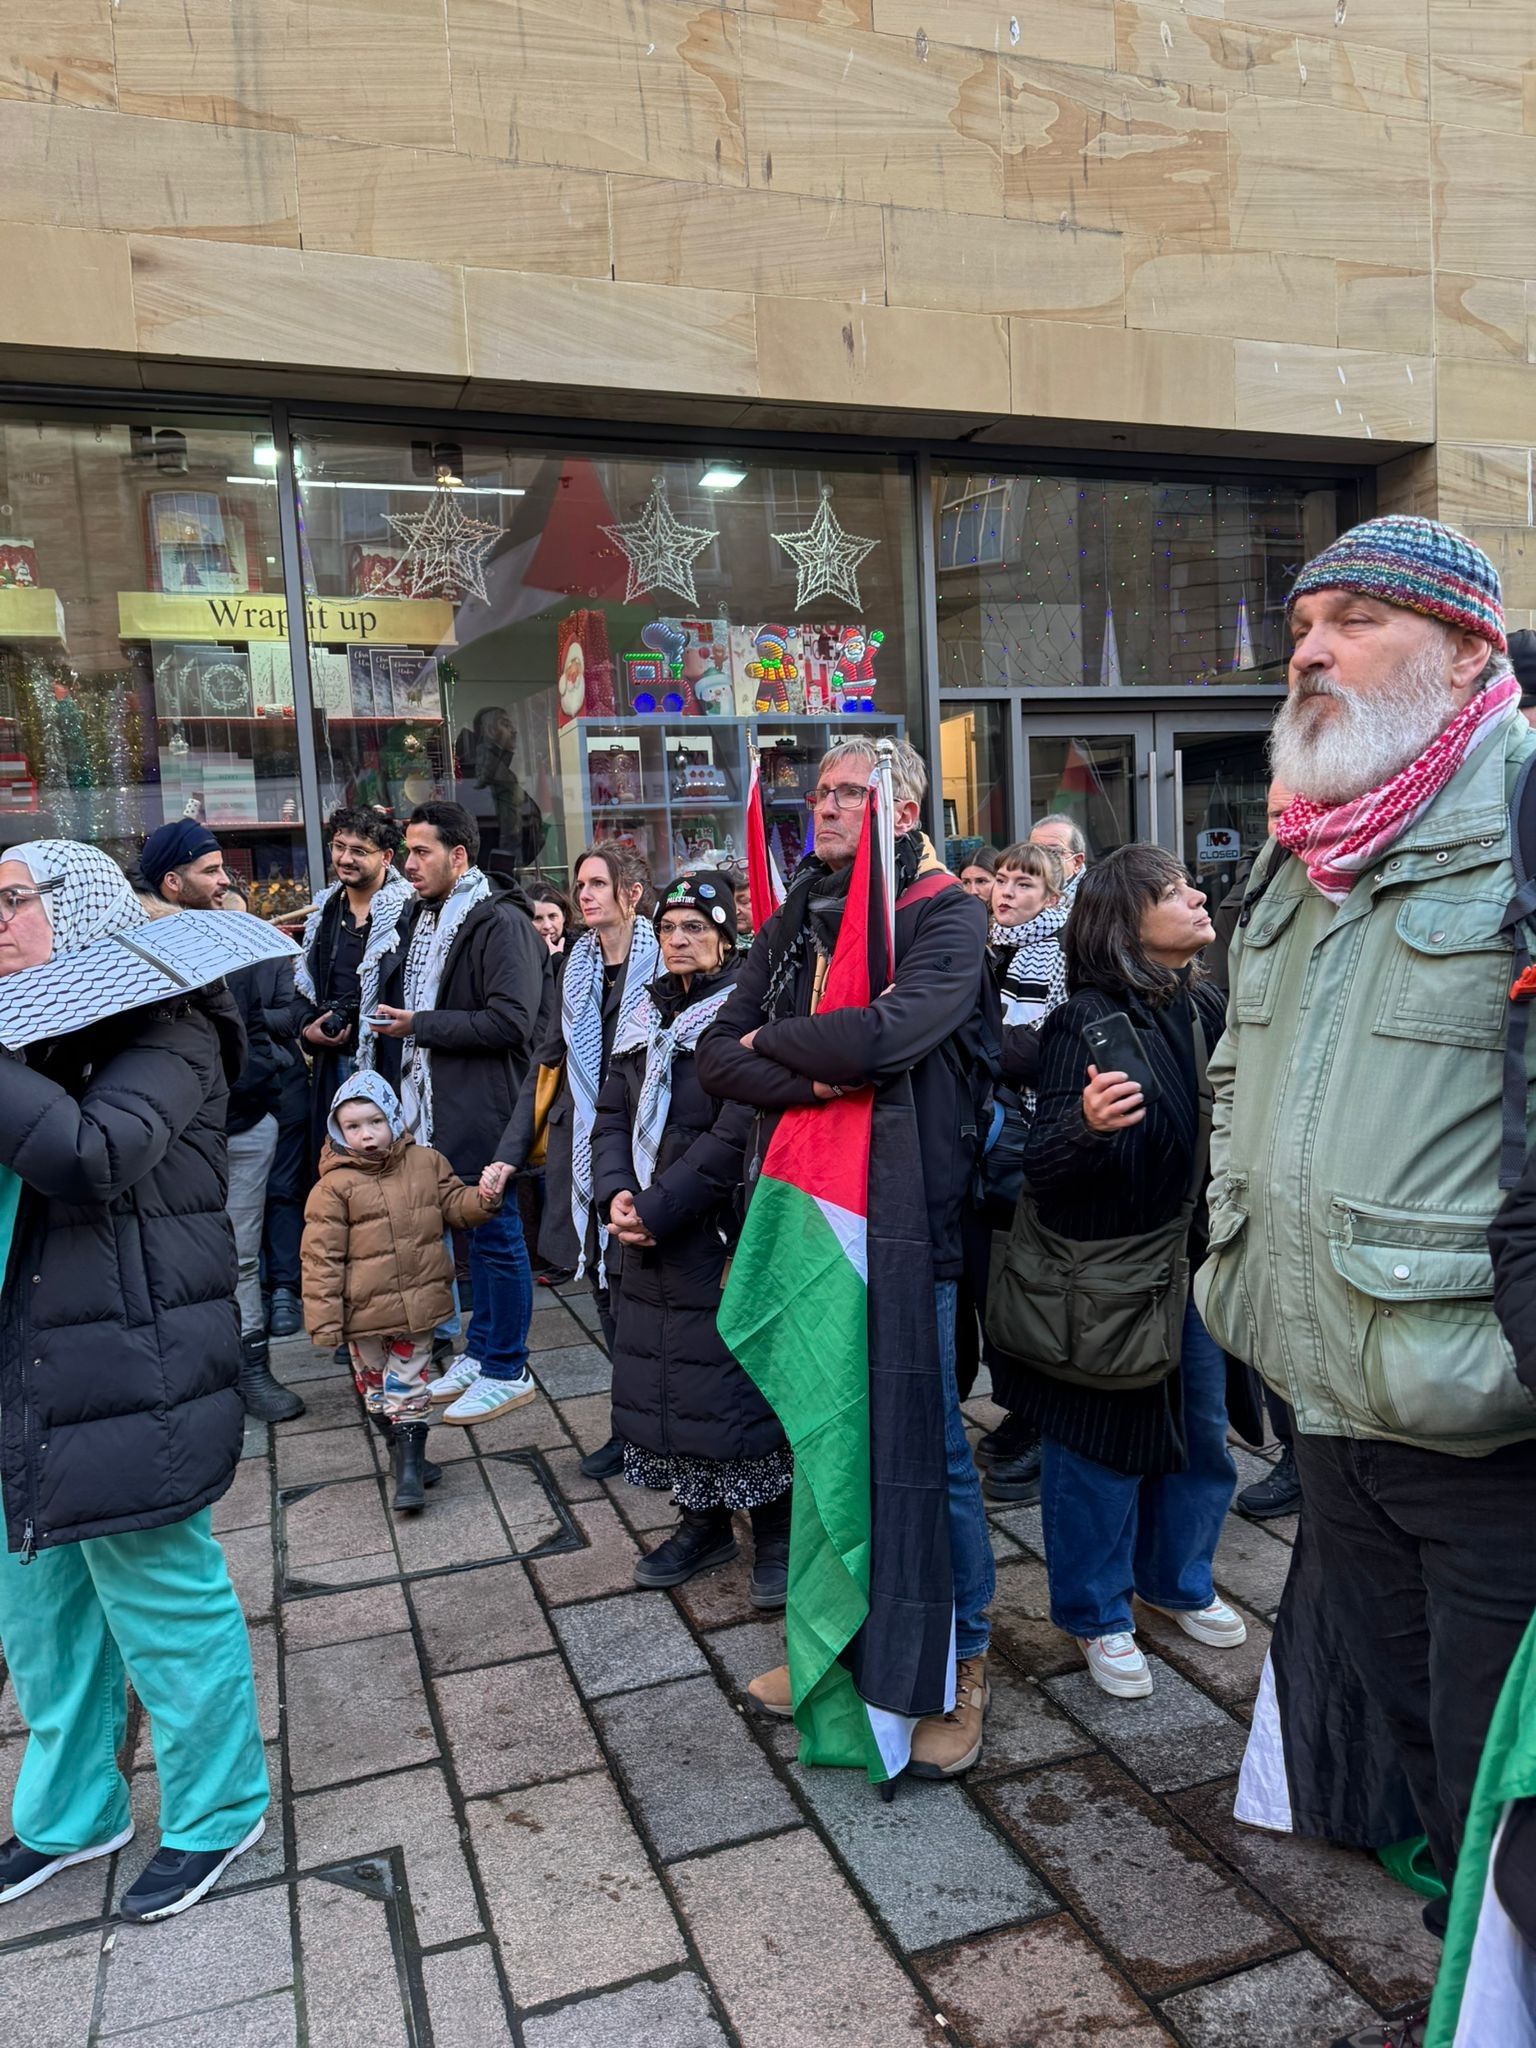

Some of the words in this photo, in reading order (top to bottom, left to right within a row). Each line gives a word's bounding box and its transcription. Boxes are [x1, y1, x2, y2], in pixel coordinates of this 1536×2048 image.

[206, 599, 290, 636] Wrap
[308, 601, 329, 630] it
[338, 608, 377, 639] up
[1200, 849, 1238, 860] CLOSED
